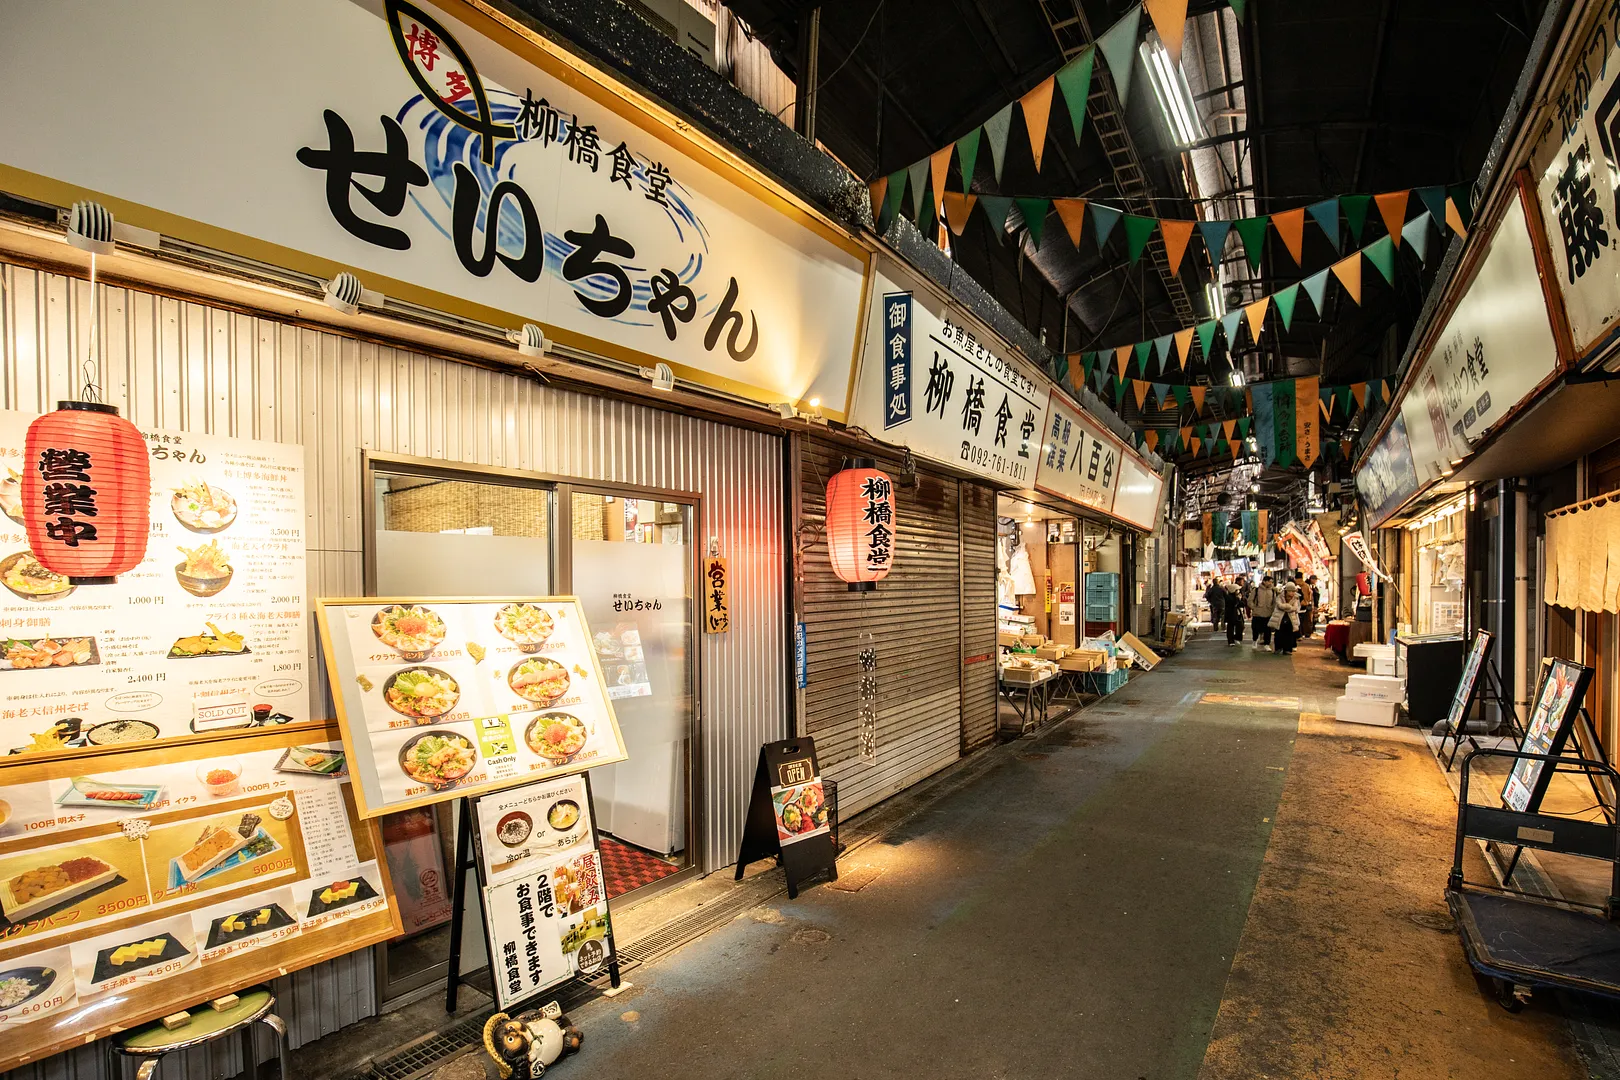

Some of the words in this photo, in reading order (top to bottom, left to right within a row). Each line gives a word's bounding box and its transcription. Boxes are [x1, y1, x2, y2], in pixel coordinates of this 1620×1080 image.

[404, 23, 472, 104] 博多
[515, 89, 673, 208] 柳橋食堂
[1550, 144, 1609, 285] 藤
[296, 109, 758, 362] せいちゃん
[888, 302, 907, 420] 御食事処
[942, 318, 1037, 397] お魚屋さんの食堂です!
[923, 350, 1036, 460] 柳橋食堂
[970, 445, 1027, 481] 092-761-1811
[1070, 430, 1114, 488] 八百谷
[860, 476, 893, 572] 柳橋食堂
[271, 595, 300, 604] 2,000円
[612, 599, 662, 612] せいちゃん
[273, 662, 302, 672] 1,800円
[127, 672, 166, 684] 2,400円
[2, 702, 89, 719] 海老天信州そば
[198, 709, 224, 719] SOLD
[226, 705, 247, 716] OUT
[388, 719, 410, 729] 漬け丼
[487, 757, 503, 766] Cash
[503, 755, 517, 764] Only
[273, 780, 287, 788] ウニ
[787, 767, 805, 783] OPEN
[175, 795, 197, 804] イクラ
[242, 783, 270, 793] 1000円
[498, 788, 573, 811] 全メニューどちらかお選びください
[57, 813, 86, 824] 明太子
[143, 800, 170, 811] 700円
[23, 819, 55, 831] 100円
[537, 830, 546, 838] or
[558, 834, 578, 848] あら汁
[253, 858, 293, 875] 5000円
[506, 849, 531, 863] 冷or温
[582, 854, 600, 905] 昼飲み
[97, 894, 149, 915] 3500円
[360, 897, 385, 911] 650円
[537, 873, 555, 918] 2階で
[271, 925, 300, 940] 550円
[515, 883, 543, 987] お食事できます
[100, 975, 138, 991] 玉子焼き
[146, 961, 182, 977] 450円
[503, 941, 522, 995] 柳橋食堂
[22, 996, 64, 1016] 600円
